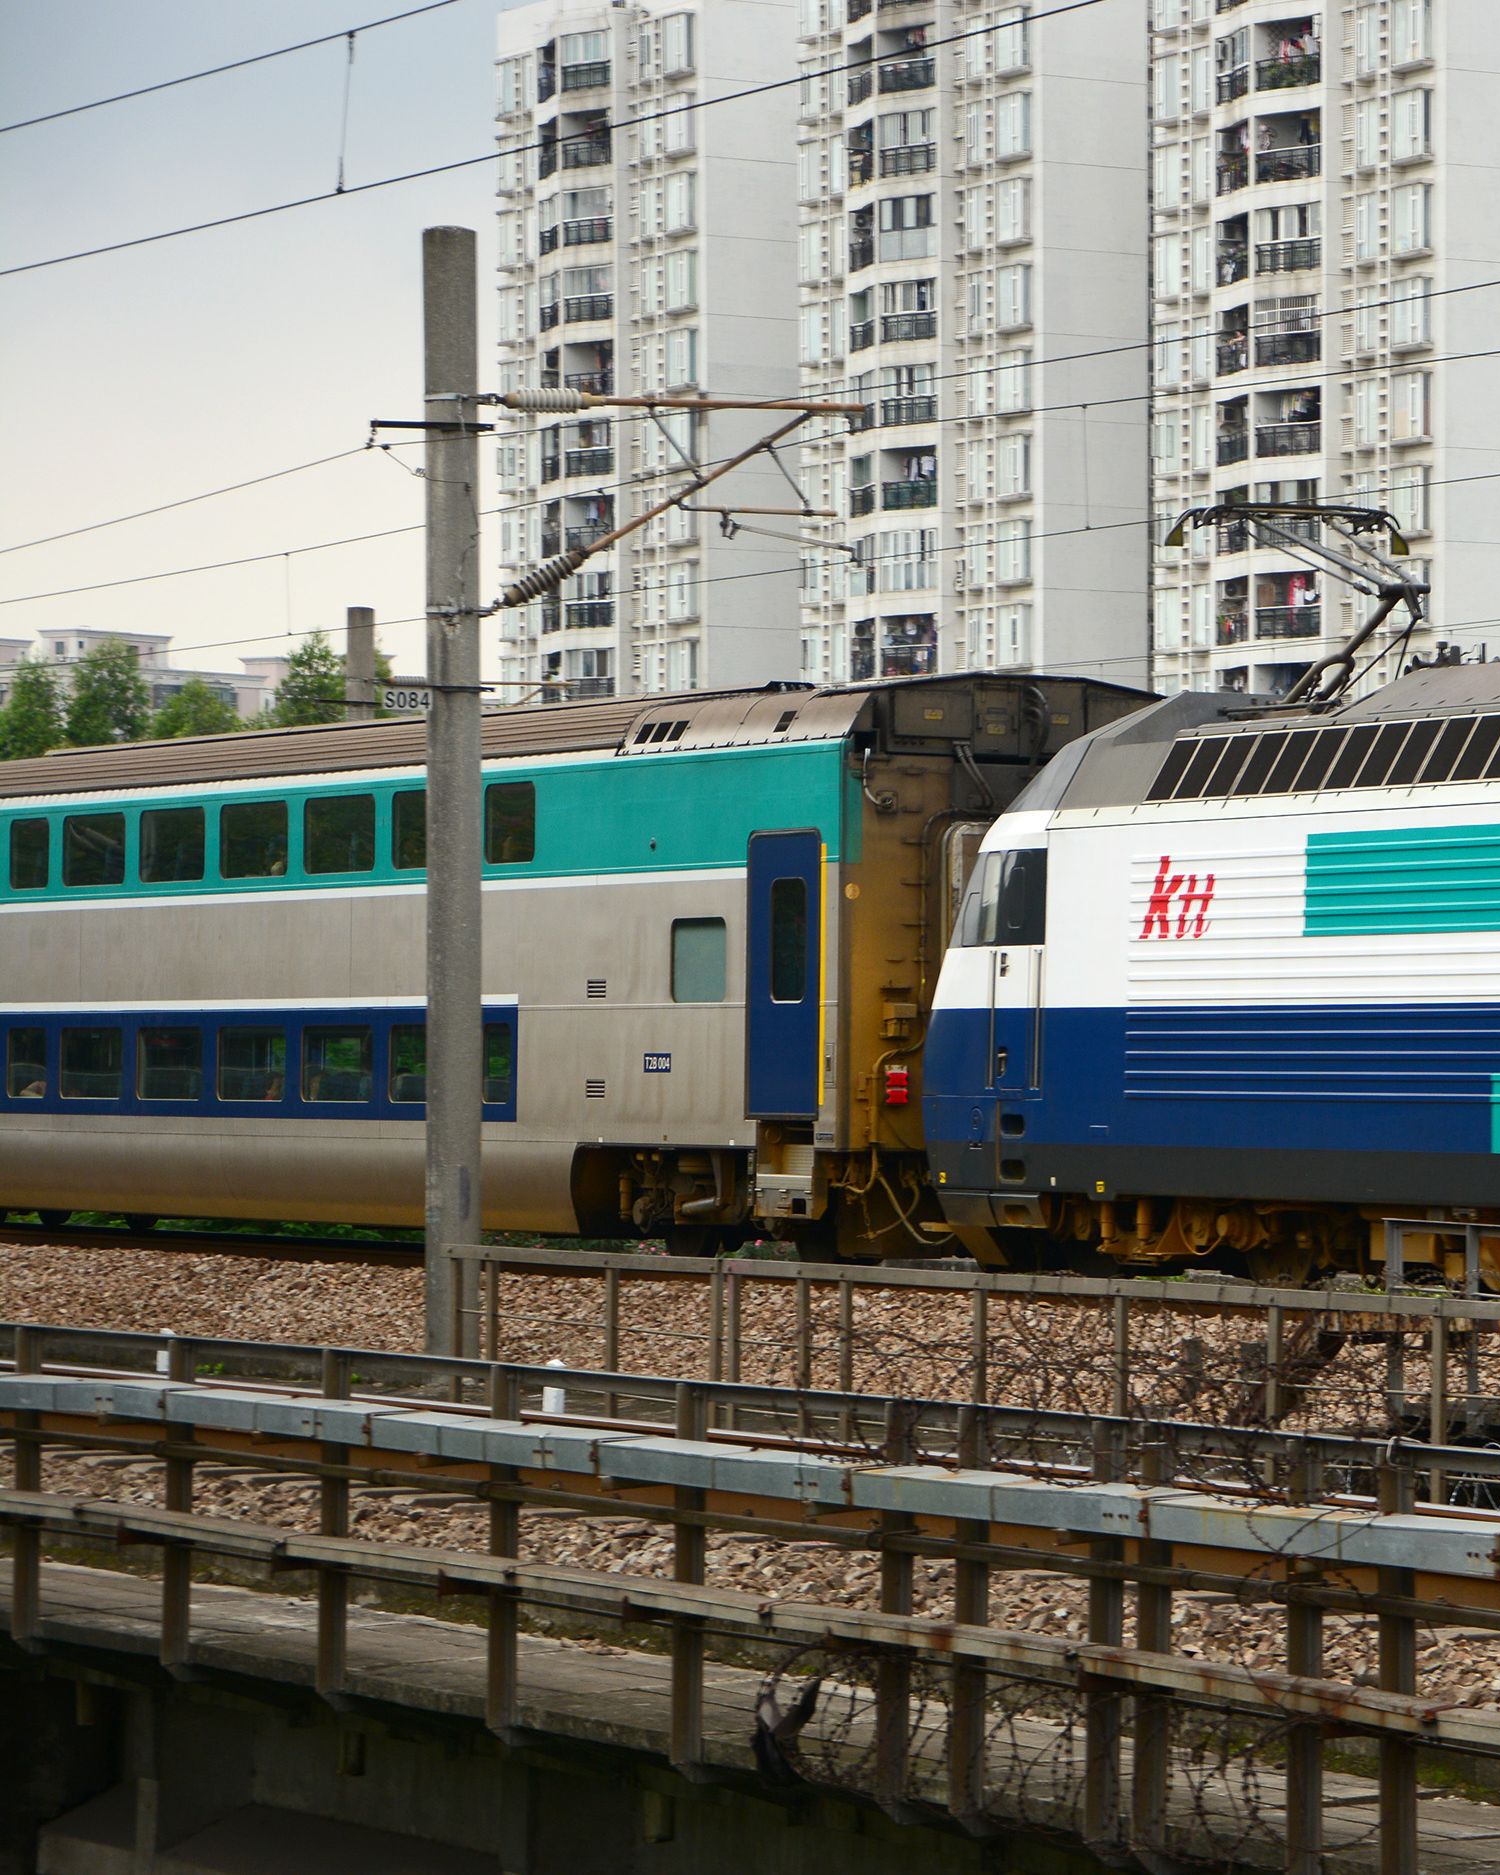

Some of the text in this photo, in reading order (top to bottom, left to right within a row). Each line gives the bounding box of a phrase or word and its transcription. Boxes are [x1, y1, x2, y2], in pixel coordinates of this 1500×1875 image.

[385, 691, 430, 708] S084
[645, 1056, 670, 1069] T2B 004
